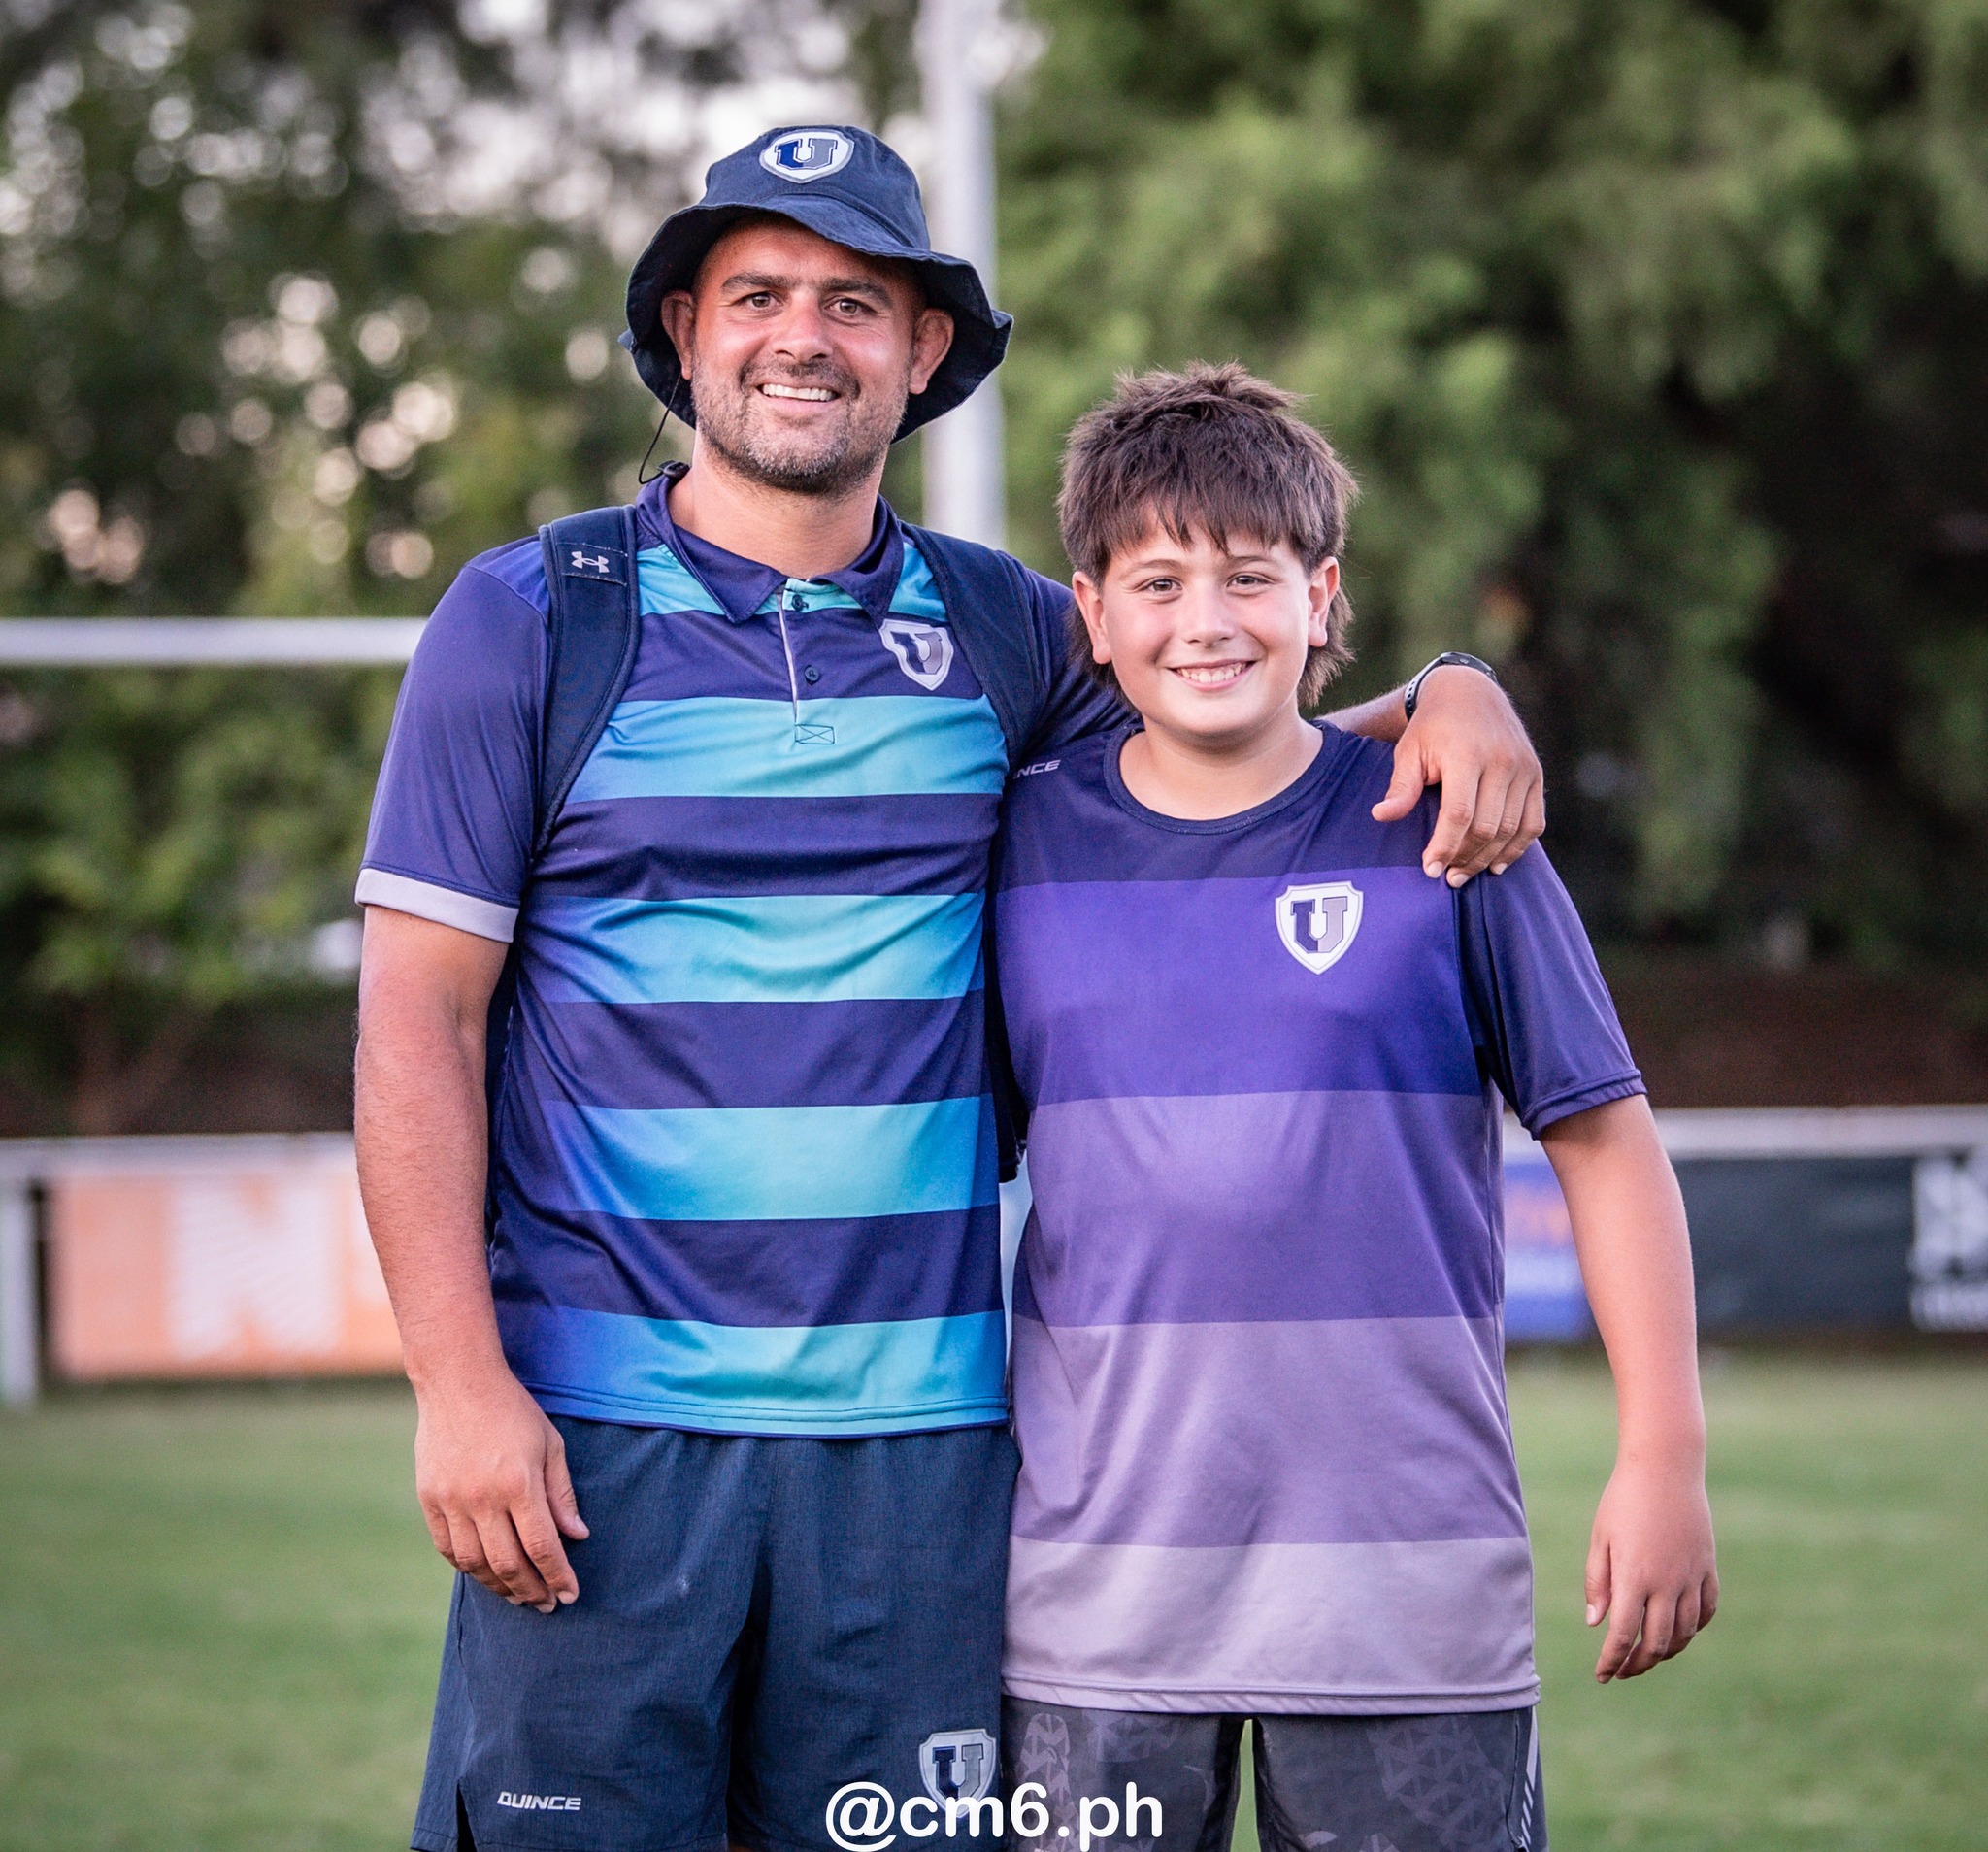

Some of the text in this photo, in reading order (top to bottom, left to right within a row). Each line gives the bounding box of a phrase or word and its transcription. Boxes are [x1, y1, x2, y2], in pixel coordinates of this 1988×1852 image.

[775, 138, 838, 170] U
[890, 631, 943, 675] U
[1290, 896, 1348, 954] U
[932, 1743, 984, 1801] U
[497, 1791, 582, 1811] QUINCE
